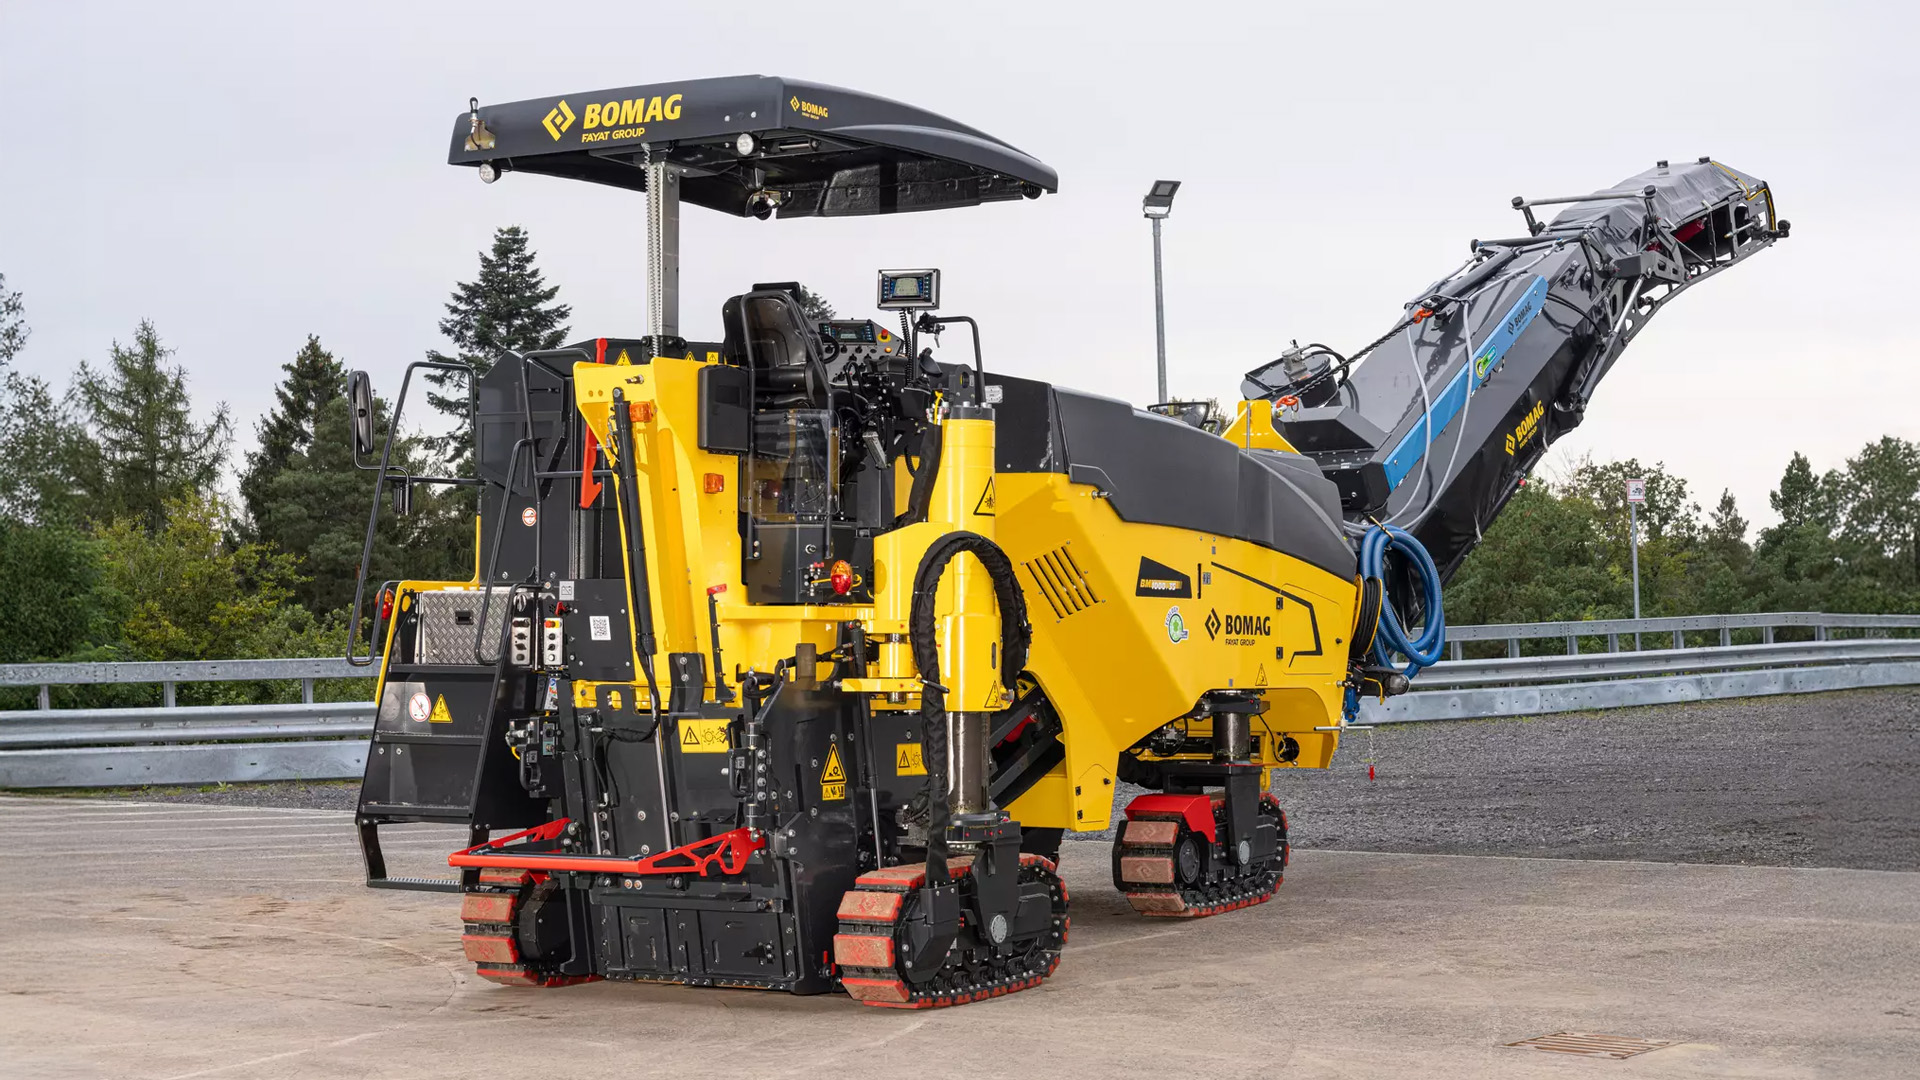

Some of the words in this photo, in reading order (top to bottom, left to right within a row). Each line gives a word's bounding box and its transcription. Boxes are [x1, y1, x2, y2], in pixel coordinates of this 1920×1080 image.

[583, 93, 683, 130] BOMAG
[801, 100, 829, 118] BOMAG
[581, 131, 610, 143] FAYAT
[612, 127, 646, 139] GROUP
[1515, 399, 1545, 442] BOMAG
[1225, 614, 1271, 636] BOMAG
[1225, 638, 1239, 646] FAYAT
[1240, 638, 1256, 646] GROUP
